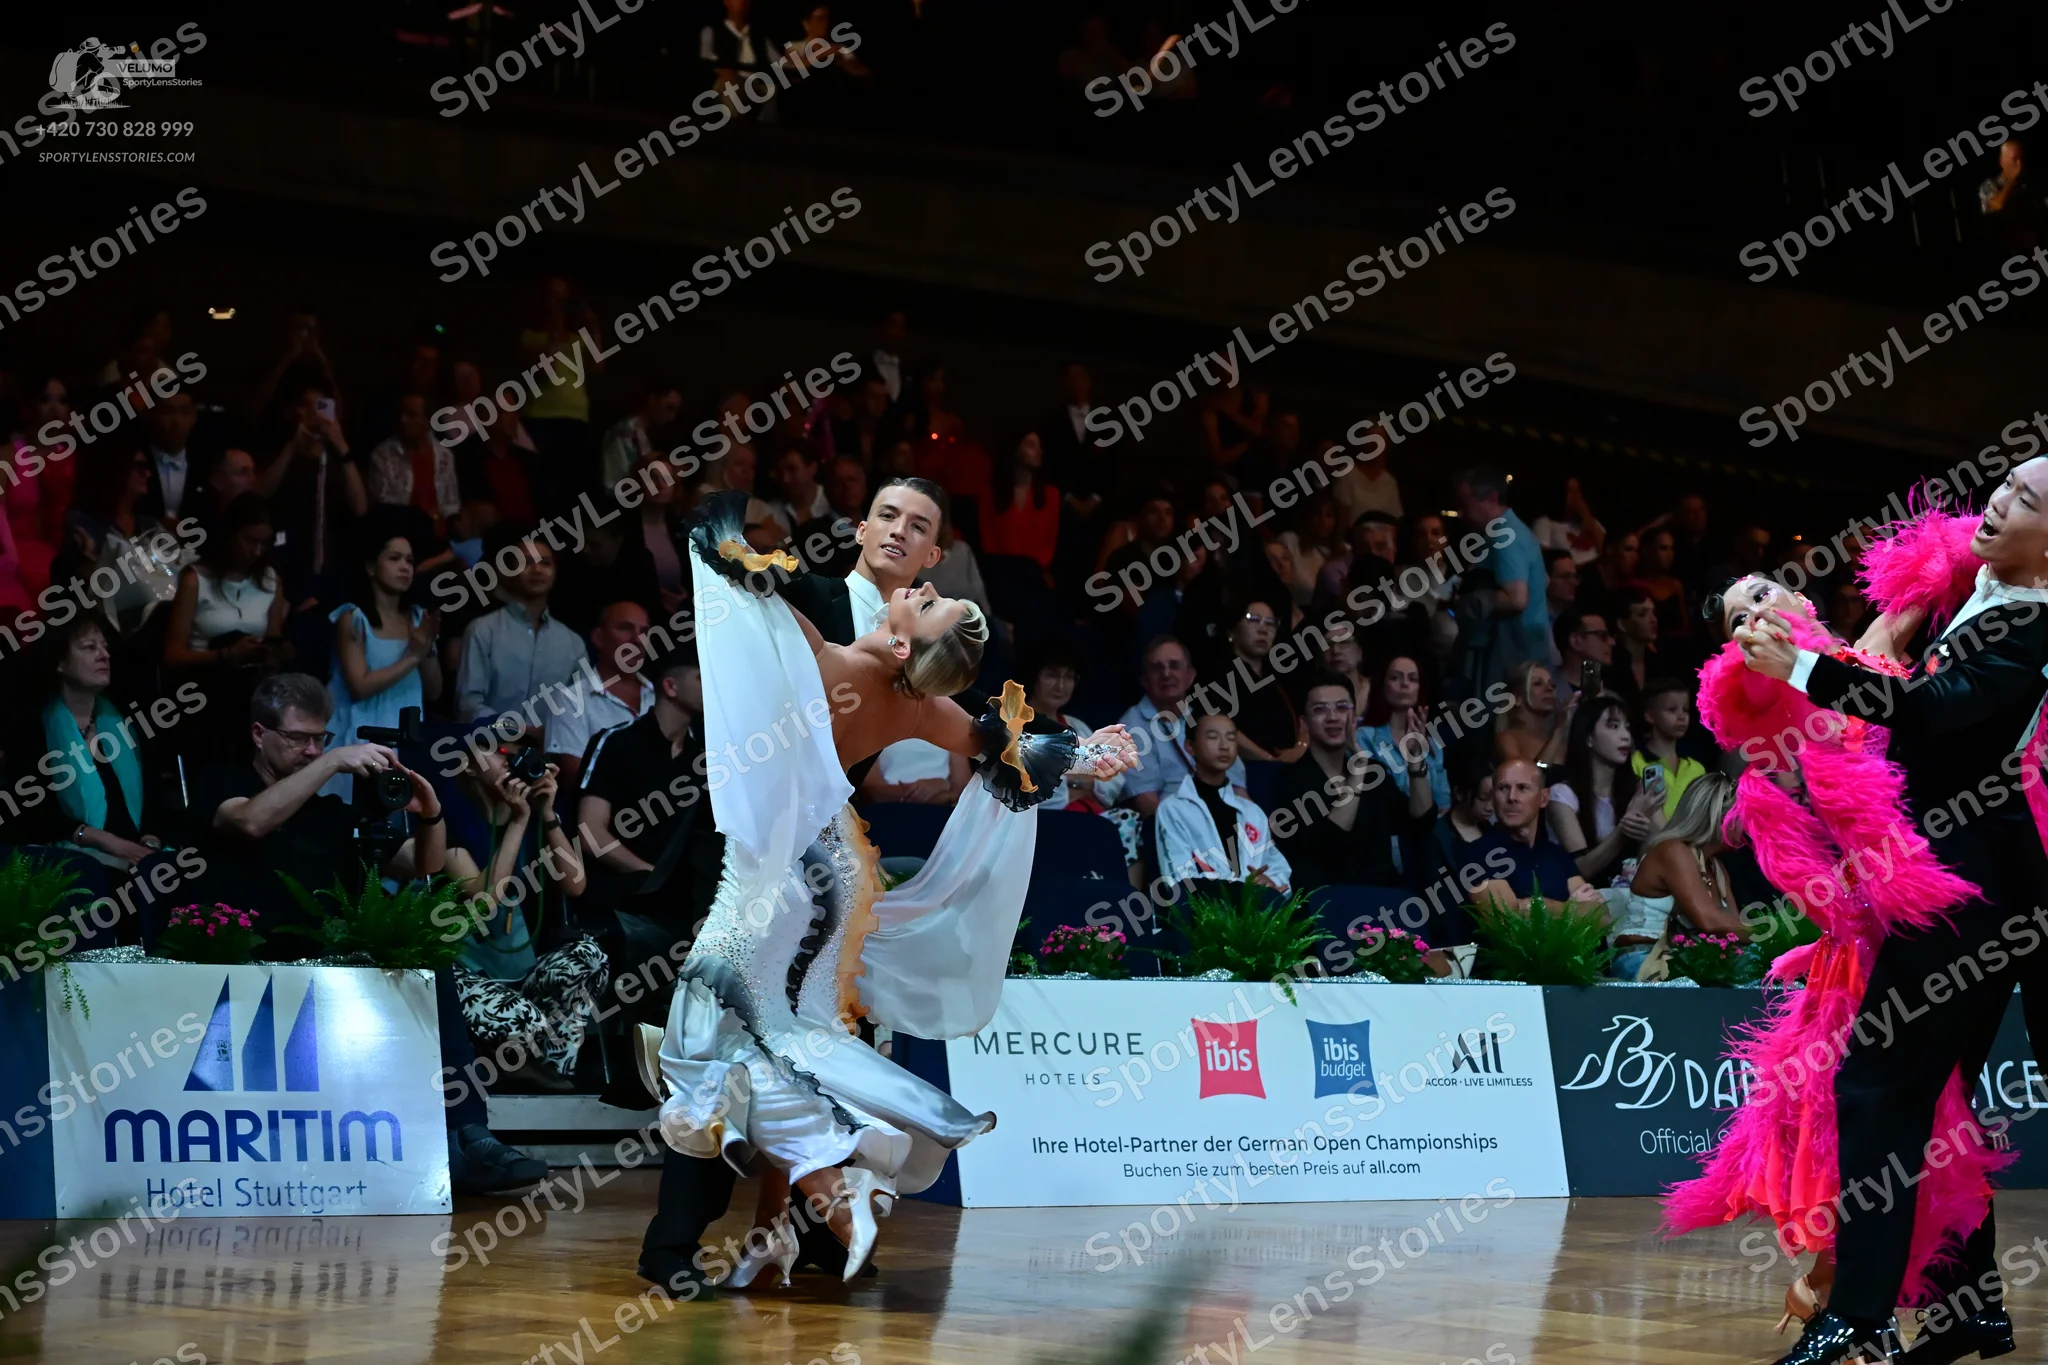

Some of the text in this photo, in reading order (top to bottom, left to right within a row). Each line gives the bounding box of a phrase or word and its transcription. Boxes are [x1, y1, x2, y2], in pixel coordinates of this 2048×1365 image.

[973, 1032, 1144, 1055] MERCURE
[1323, 1038, 1360, 1061] ibis
[1205, 1041, 1253, 1072] ibis
[1025, 1074, 1101, 1085] HOTELS
[1321, 1061, 1367, 1081] budget
[1426, 1078, 1533, 1087] ACCOR LIVE LIMITLESS
[104, 1109, 403, 1162] MARITIM
[1032, 1133, 1498, 1154] Ihre Hotel-Partner der German Open Championships
[1640, 1128, 1711, 1154] Official
[1123, 1160, 1421, 1177] Buchen Sie zum besten Preis auf all.com
[146, 1177, 367, 1214] Hotel Stuttgart
